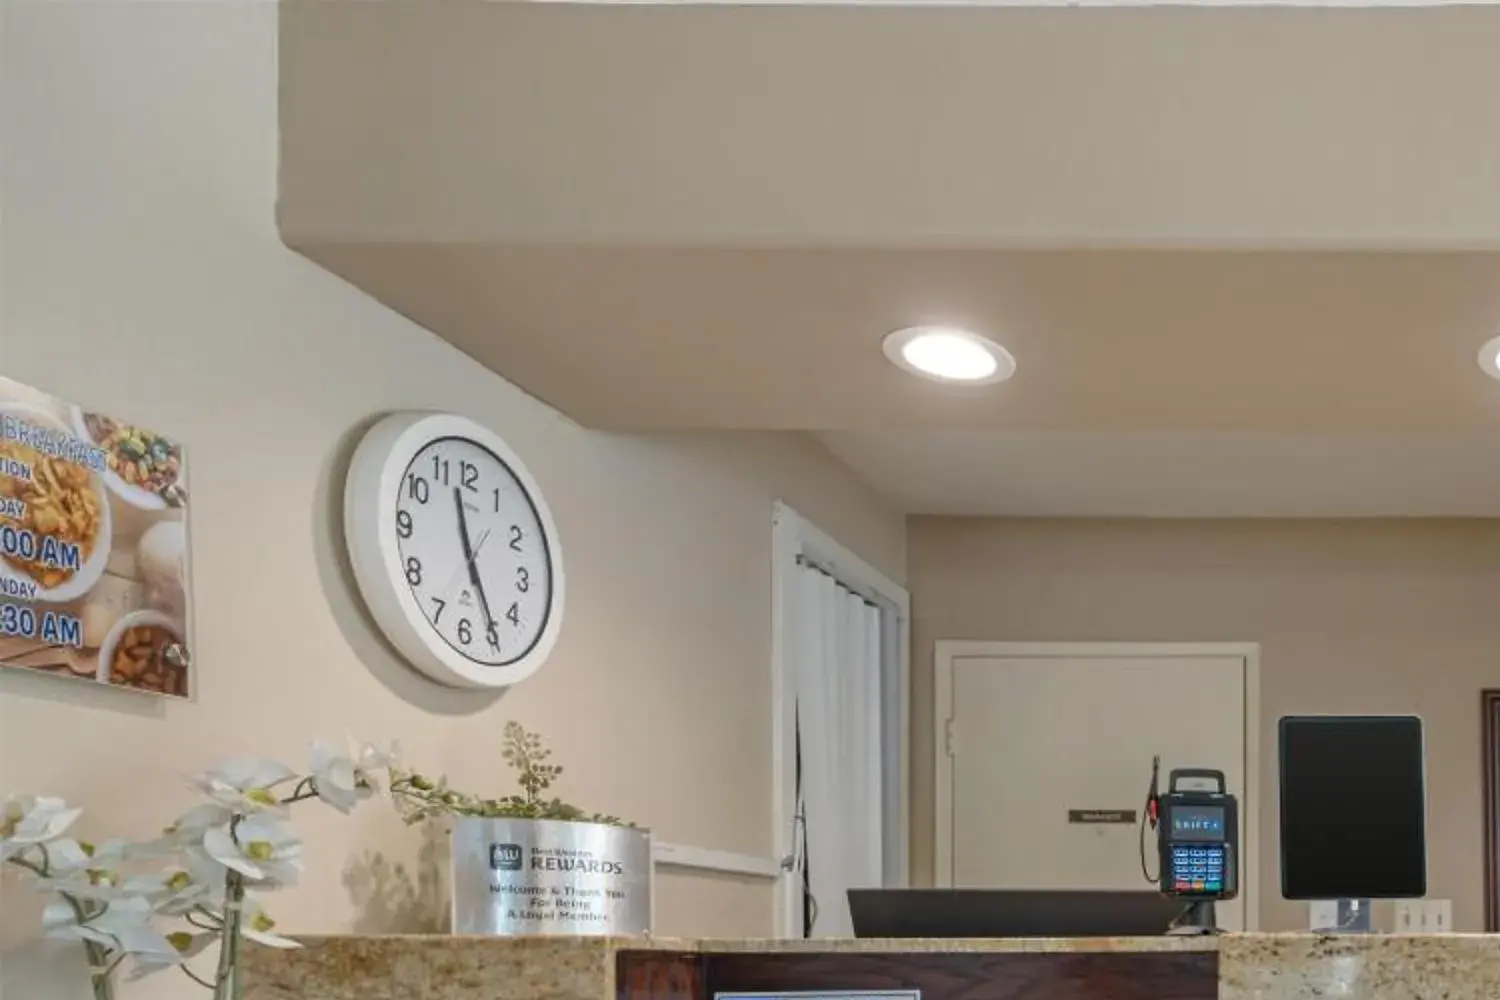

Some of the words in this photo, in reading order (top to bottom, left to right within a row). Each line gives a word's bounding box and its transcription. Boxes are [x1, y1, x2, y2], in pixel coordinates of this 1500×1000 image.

[432, 455, 449, 486] 11
[459, 461, 479, 492] 12
[407, 473, 429, 504] 10
[492, 488, 499, 512] 1
[398, 510, 413, 539] 9
[509, 525, 522, 551] 2
[42, 538, 80, 572] AM
[406, 557, 421, 586] 8
[516, 567, 529, 592] 3
[431, 597, 446, 624] 7
[506, 602, 519, 626] 4
[43, 613, 81, 645] AM
[457, 619, 472, 645] 6
[531, 857, 622, 875] REWARDS
